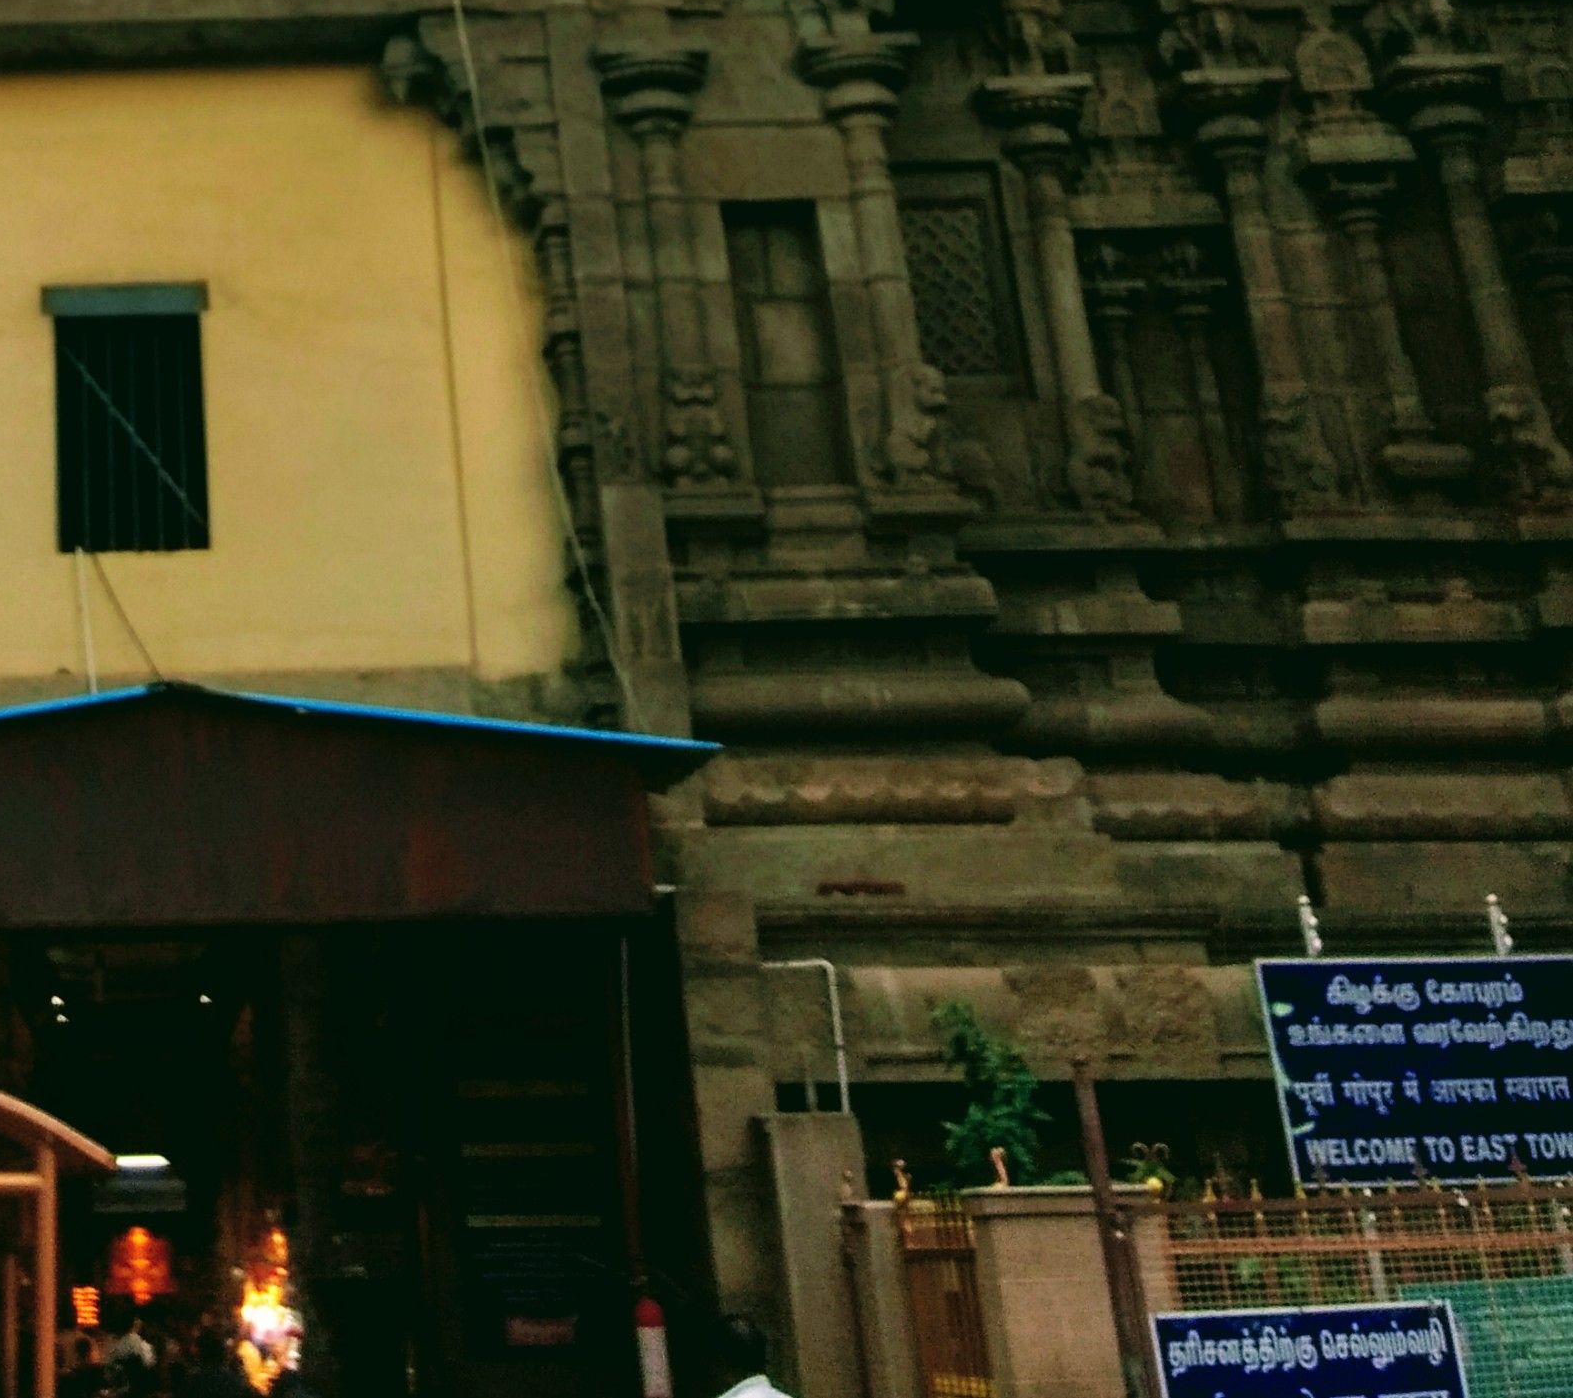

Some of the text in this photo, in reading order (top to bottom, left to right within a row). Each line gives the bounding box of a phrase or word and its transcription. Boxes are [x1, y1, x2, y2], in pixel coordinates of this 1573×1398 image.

[1327, 972, 1524, 1015] கிழக்கு கோபுரம்
[1305, 1136, 1417, 1167] WELCOME
[1423, 1135, 1456, 1163] TO
[1460, 1132, 1518, 1163] EAST
